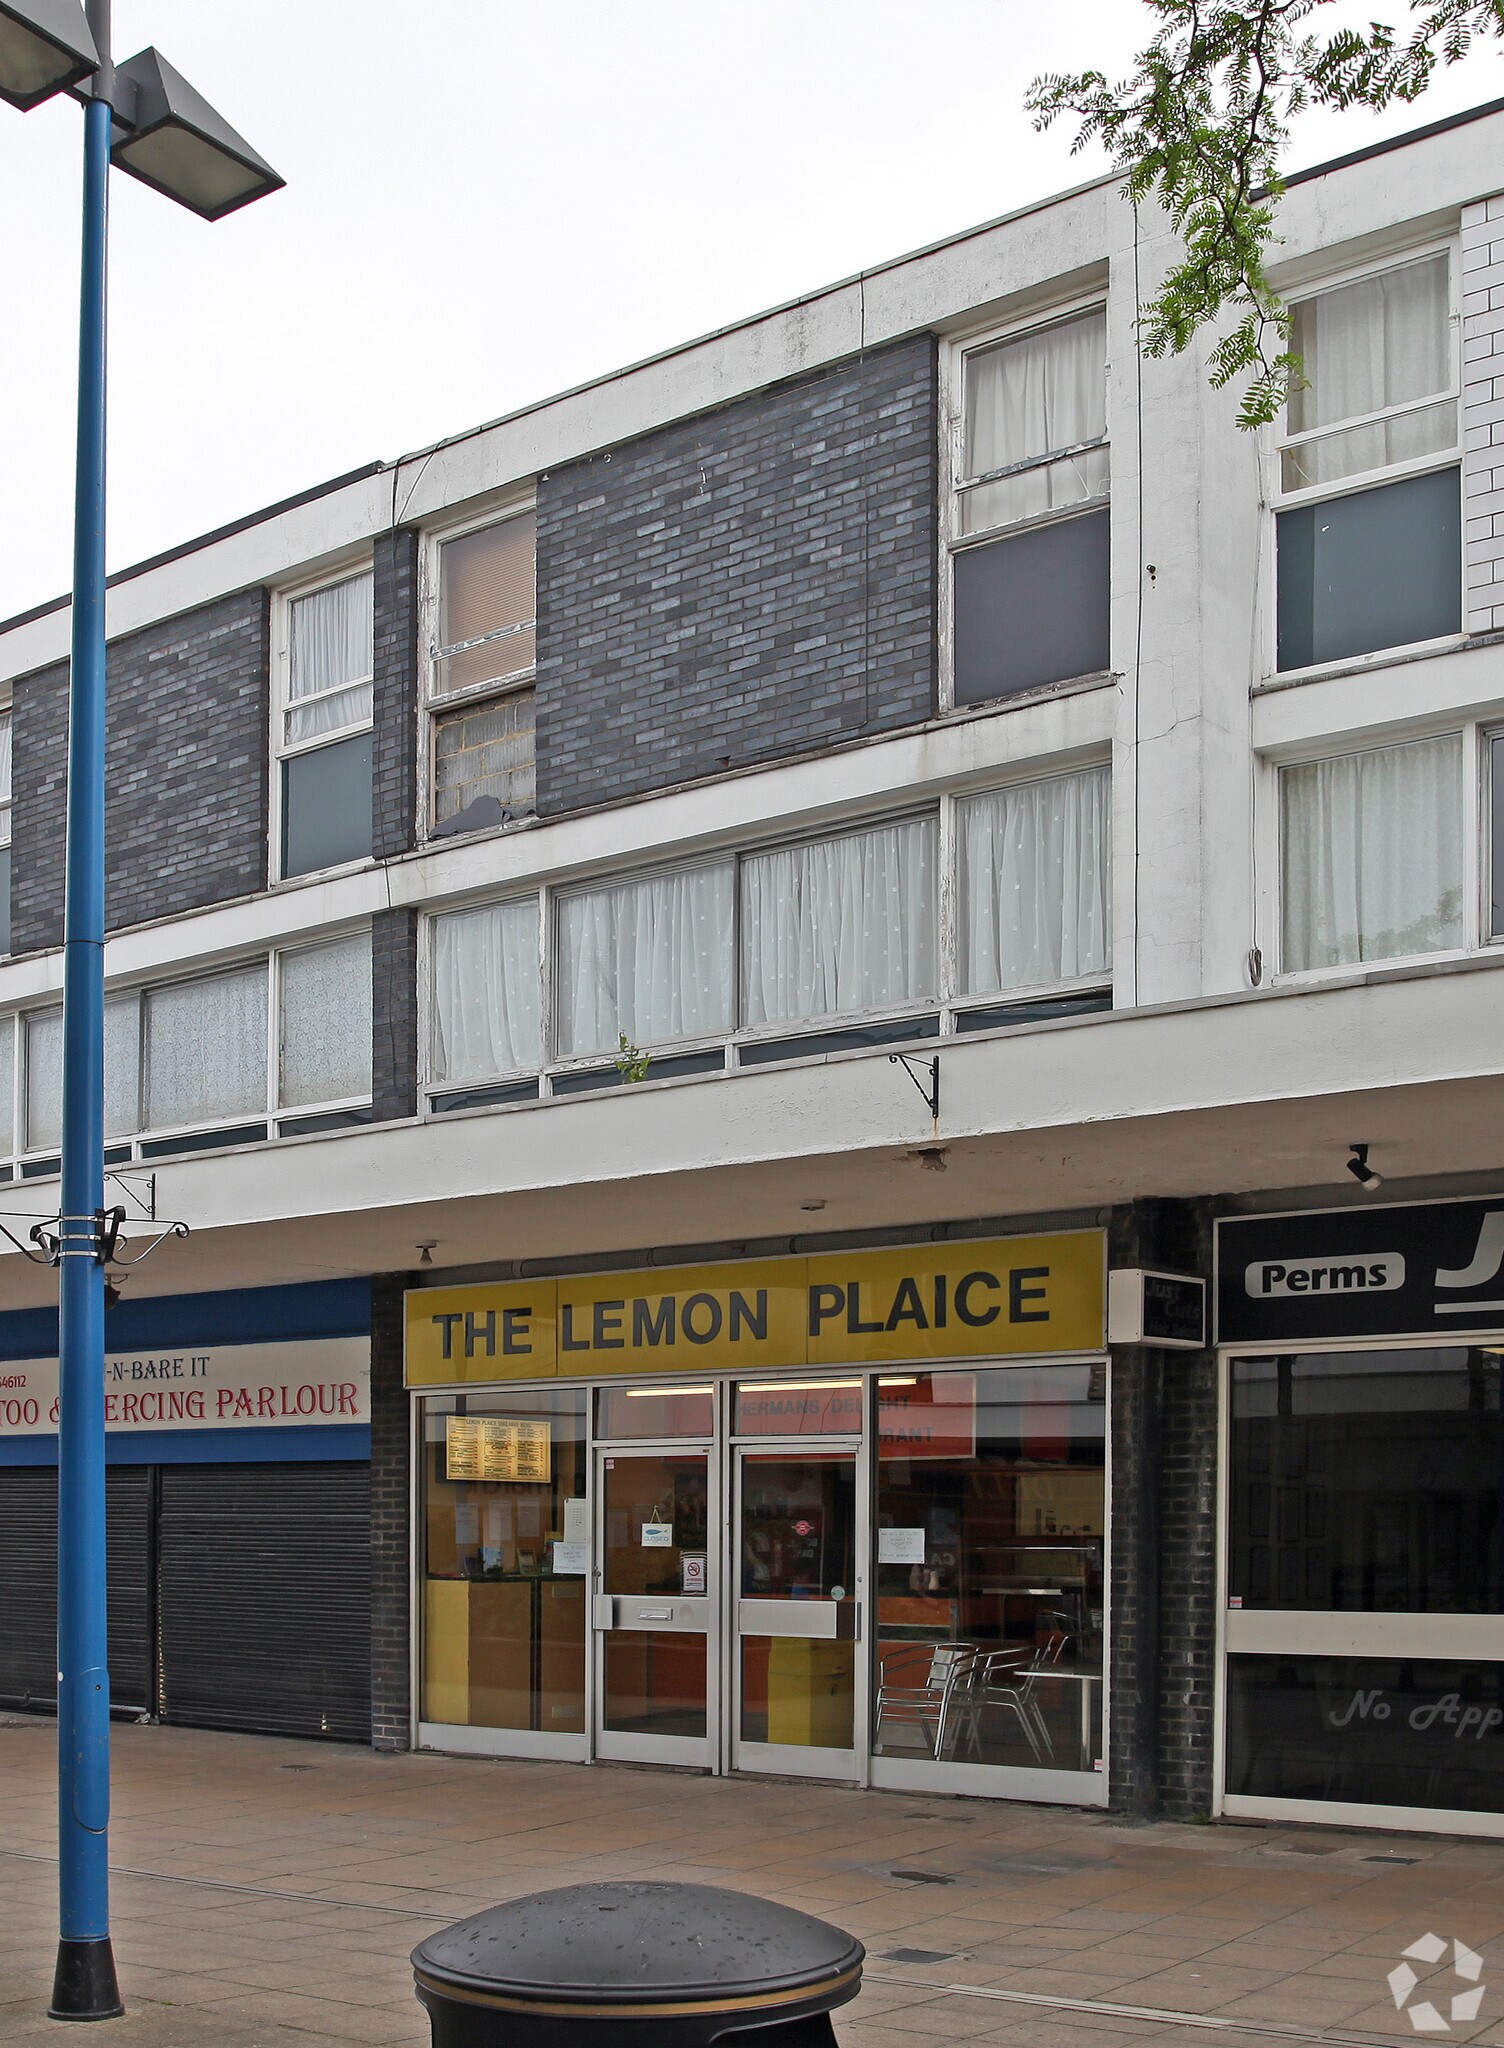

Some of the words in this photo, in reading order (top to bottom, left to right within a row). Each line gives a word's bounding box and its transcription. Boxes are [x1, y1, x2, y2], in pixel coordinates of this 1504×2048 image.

[1262, 1264, 1387, 1293] Perms
[432, 1307, 532, 1359] THE
[562, 1290, 768, 1351] LEMON
[809, 1266, 1050, 1336] PLAICE
[0, 1375, 26, 1388] 46112
[191, 1357, 210, 1377] IT
[104, 1390, 206, 1423] ERCING
[216, 1383, 361, 1419] PARLOUR
[1329, 1690, 1391, 1727] No
[1409, 1693, 1503, 1740] App
